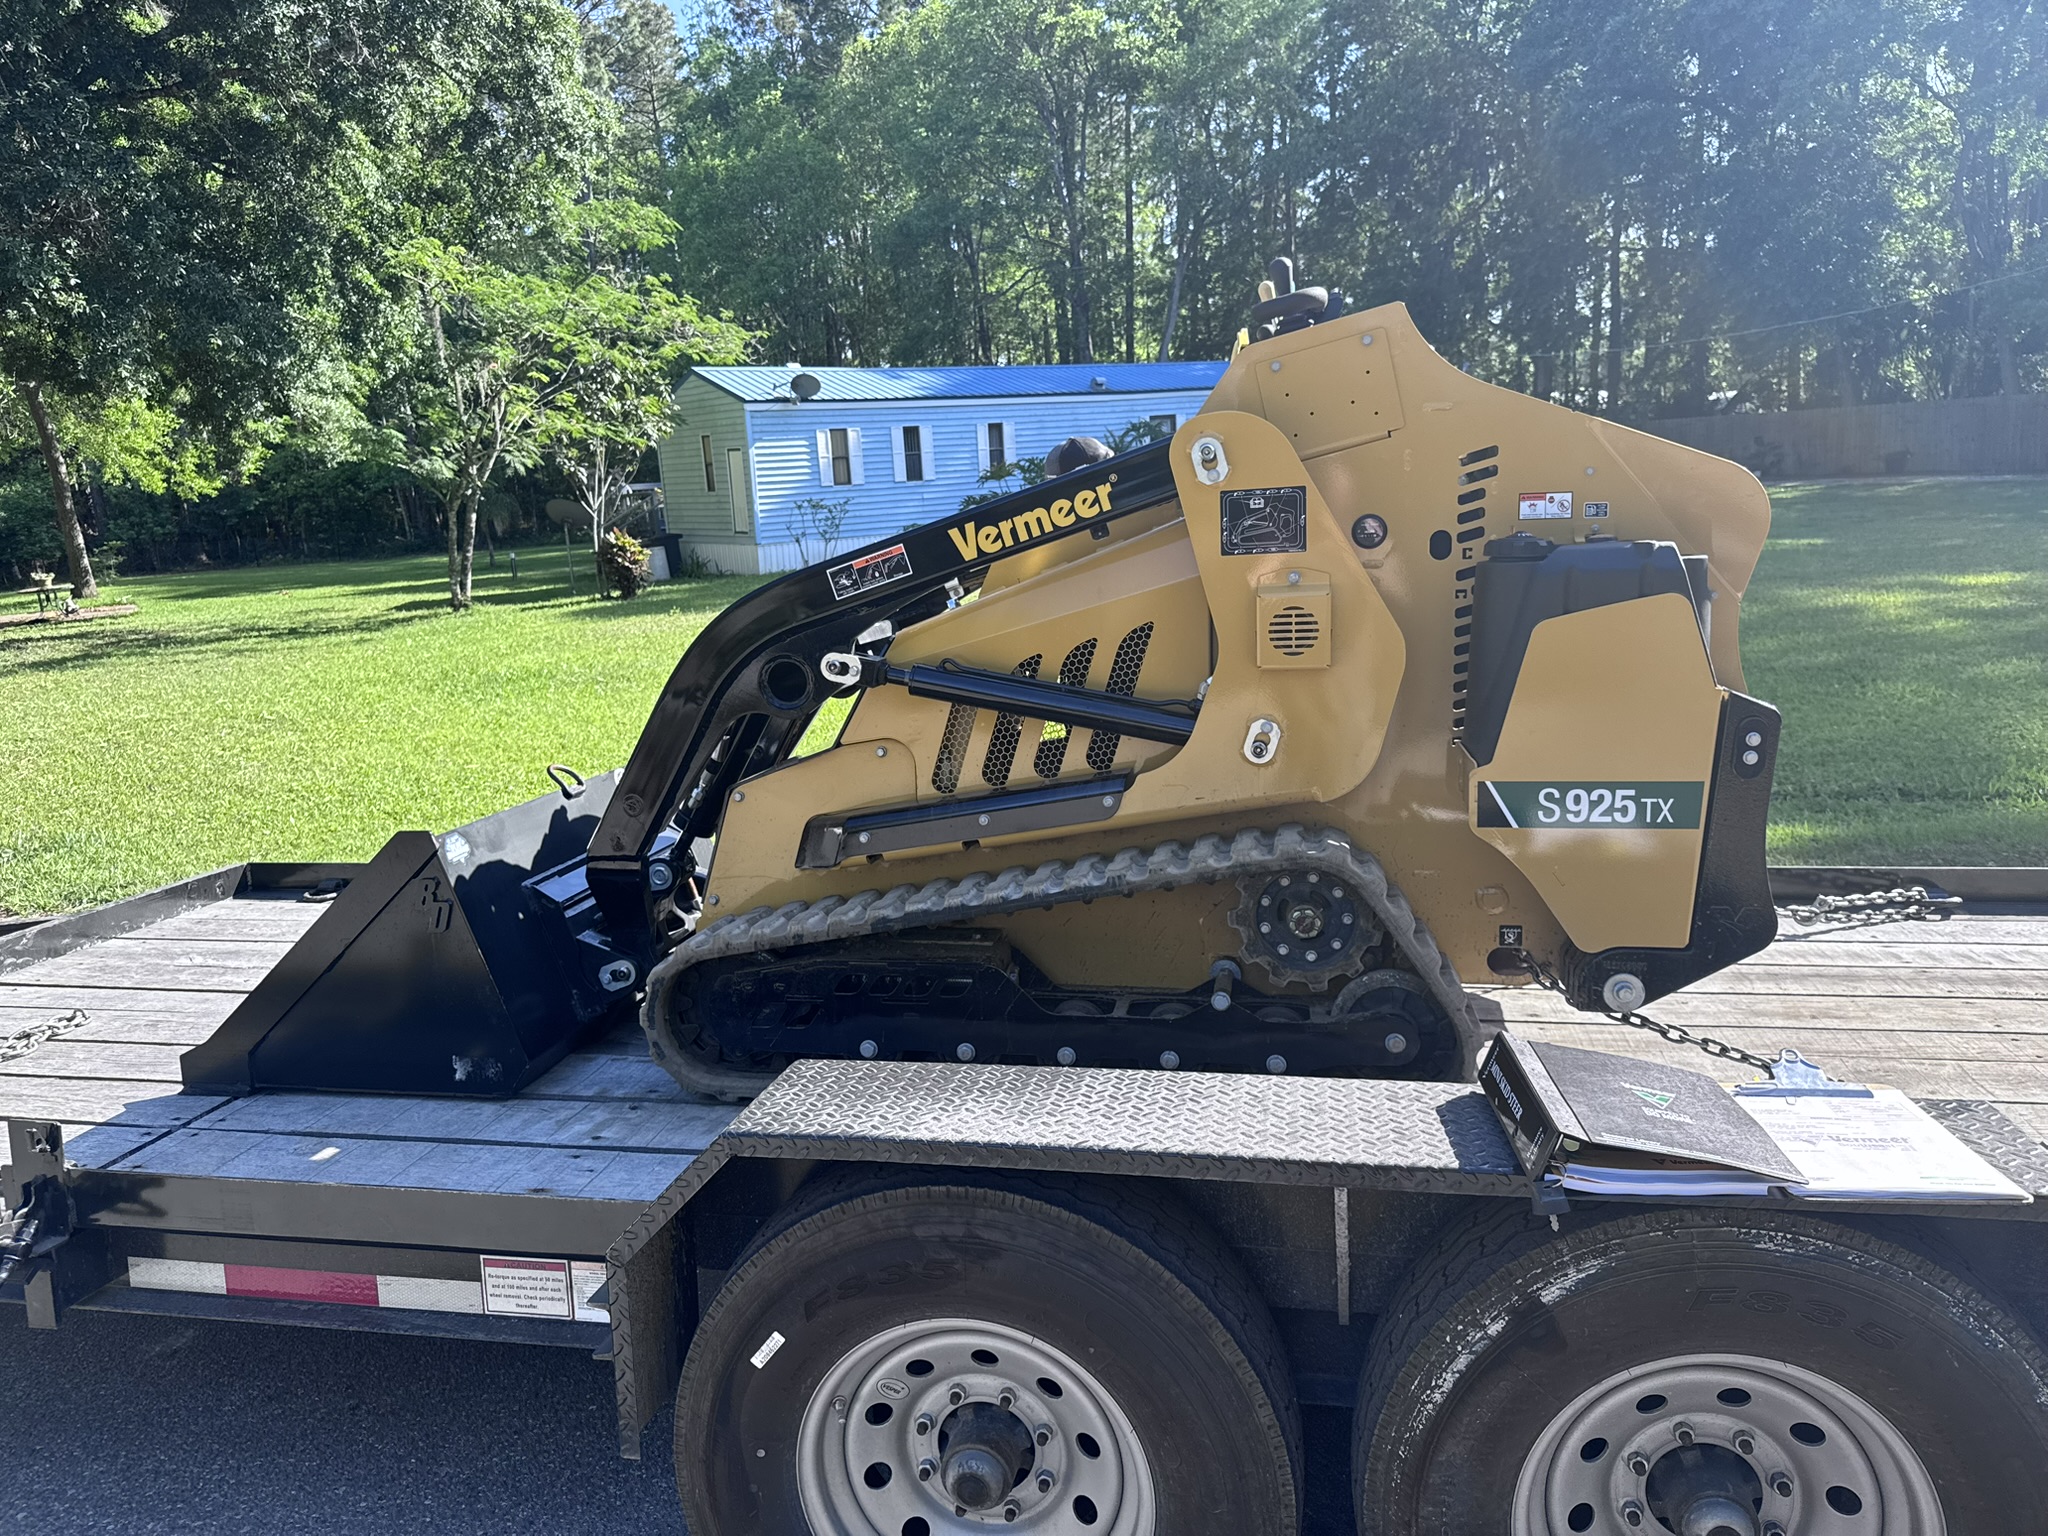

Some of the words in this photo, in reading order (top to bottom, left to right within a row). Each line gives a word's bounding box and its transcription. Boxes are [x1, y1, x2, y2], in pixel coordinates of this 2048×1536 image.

[947, 482, 1113, 562] Vermeer
[870, 550, 894, 562] WARNING
[1490, 1060, 1502, 1084] MINI
[1499, 1076, 1511, 1098] SKID
[1508, 1092, 1523, 1121] STEER
[1826, 1134, 1909, 1144] Vermeer
[510, 1262, 546, 1270] CAUTION
